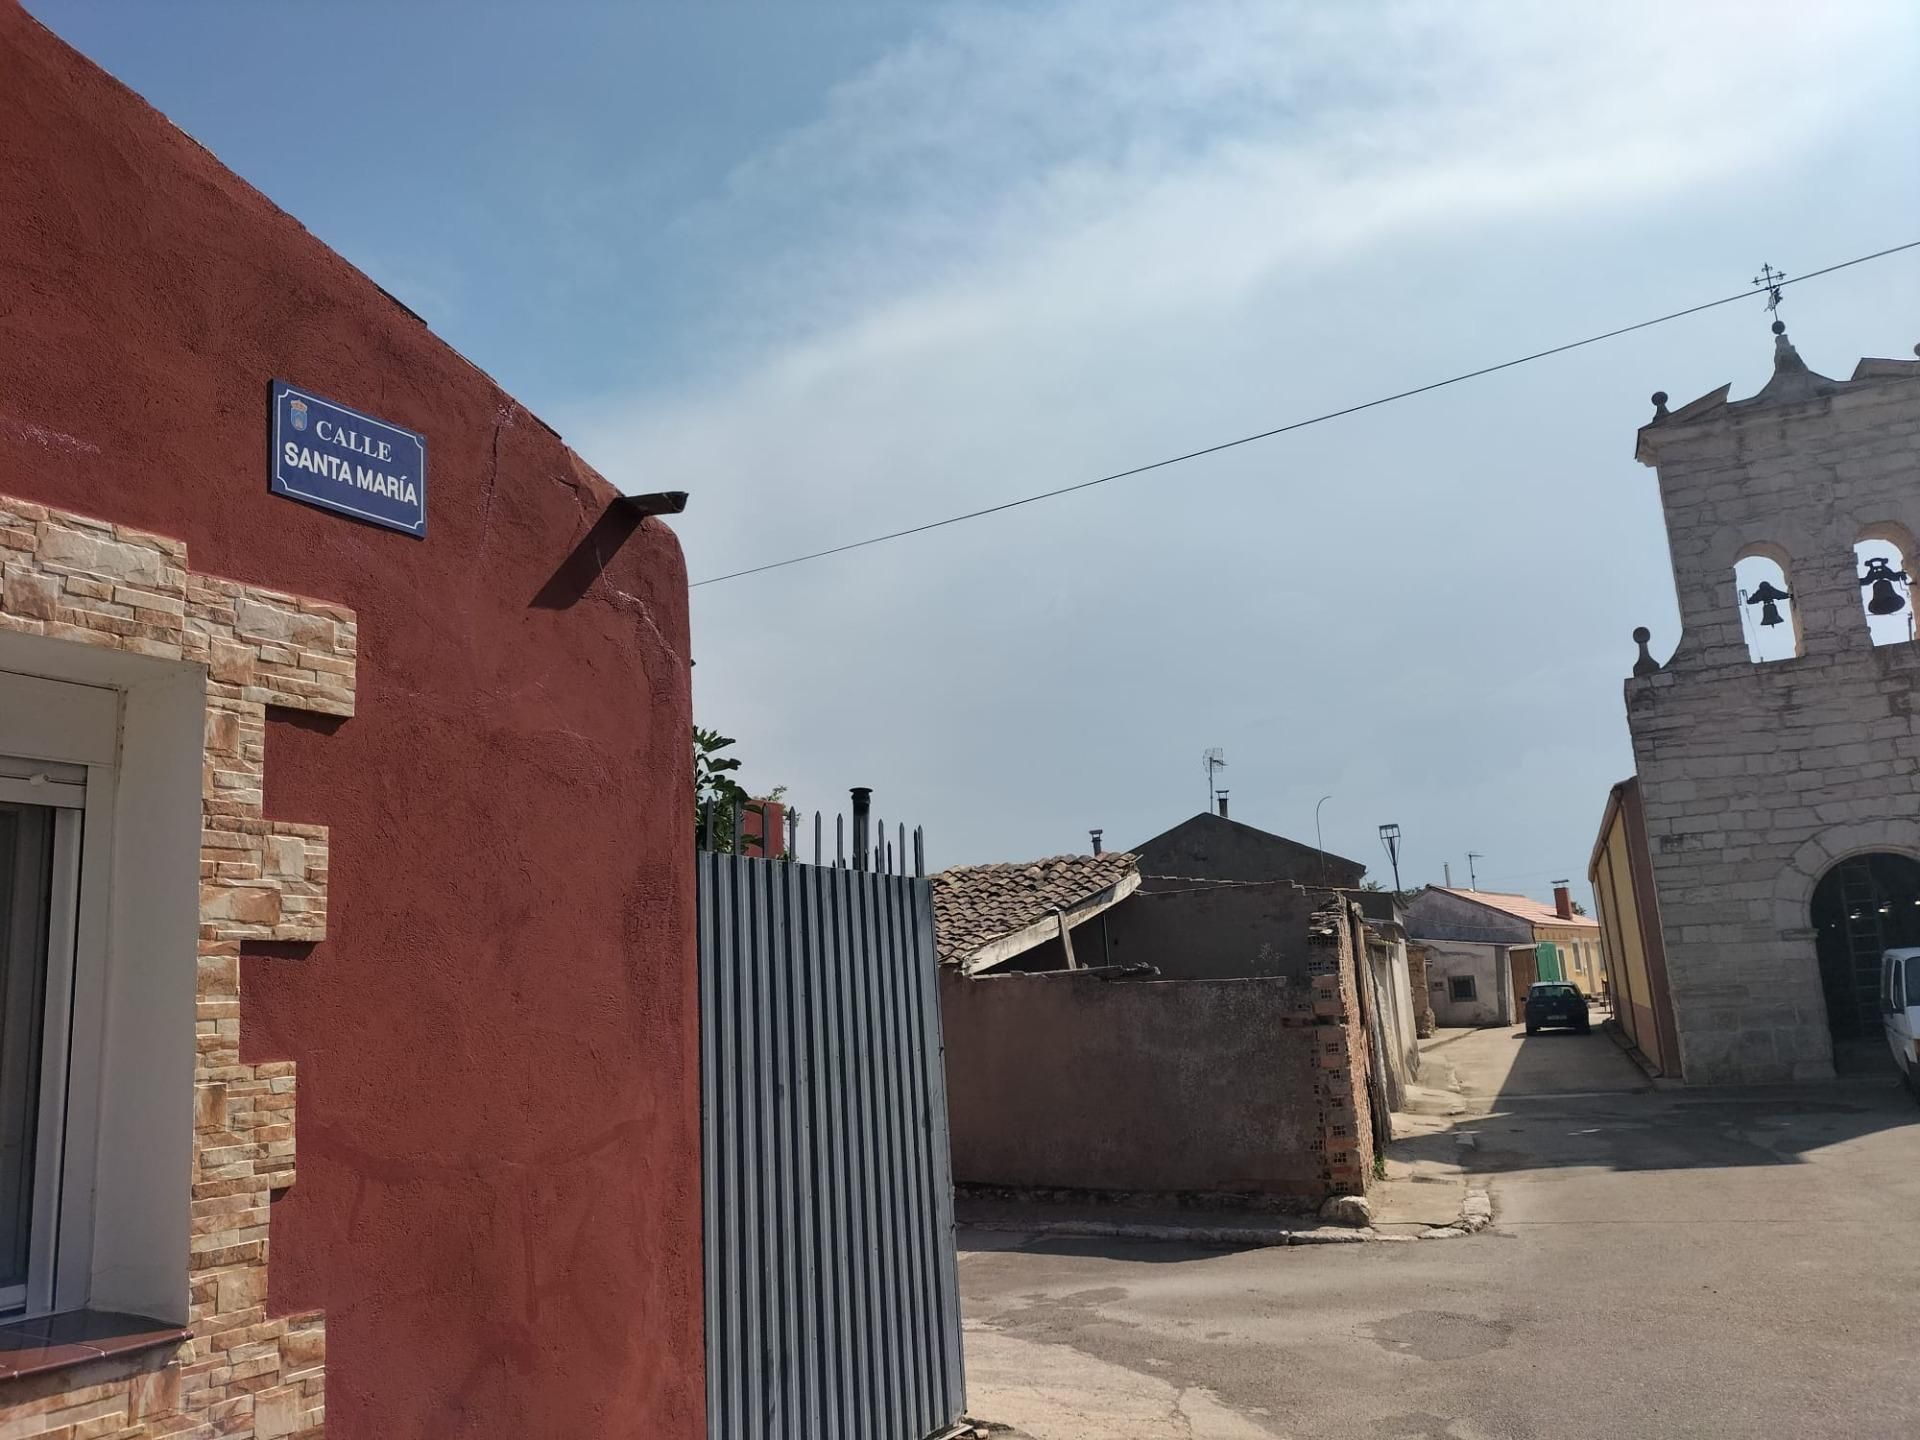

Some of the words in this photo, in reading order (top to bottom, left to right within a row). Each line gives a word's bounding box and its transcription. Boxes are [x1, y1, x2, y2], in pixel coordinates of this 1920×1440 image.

[316, 420, 392, 463] CALLE
[284, 442, 353, 485] SANTA
[356, 465, 418, 506] MARÍA
